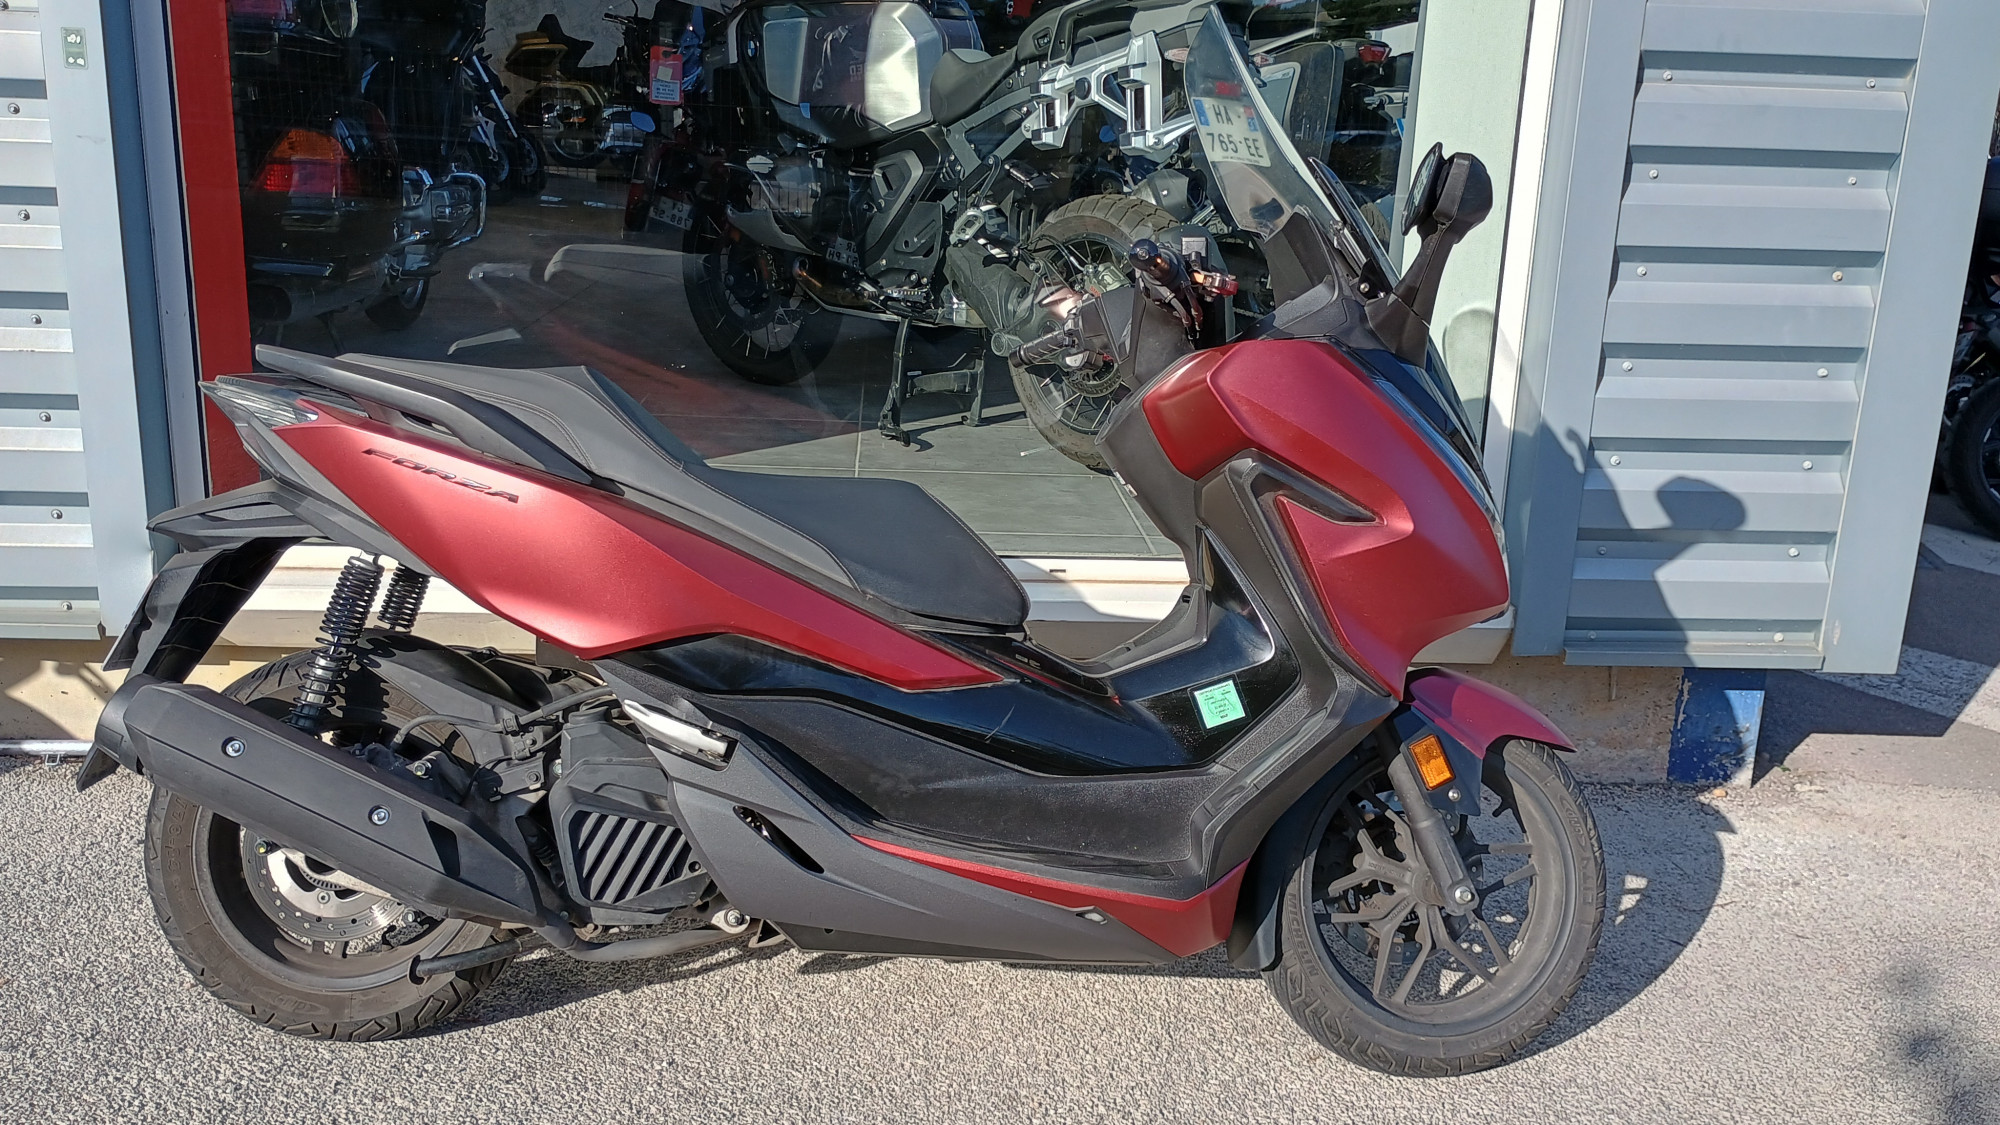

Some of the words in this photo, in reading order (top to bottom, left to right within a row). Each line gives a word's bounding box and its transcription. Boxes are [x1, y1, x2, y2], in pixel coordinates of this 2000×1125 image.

[1206, 132, 1264, 159] 765-EE
[361, 447, 520, 504] FORZA
[1288, 892, 1320, 978] MICHELIN
